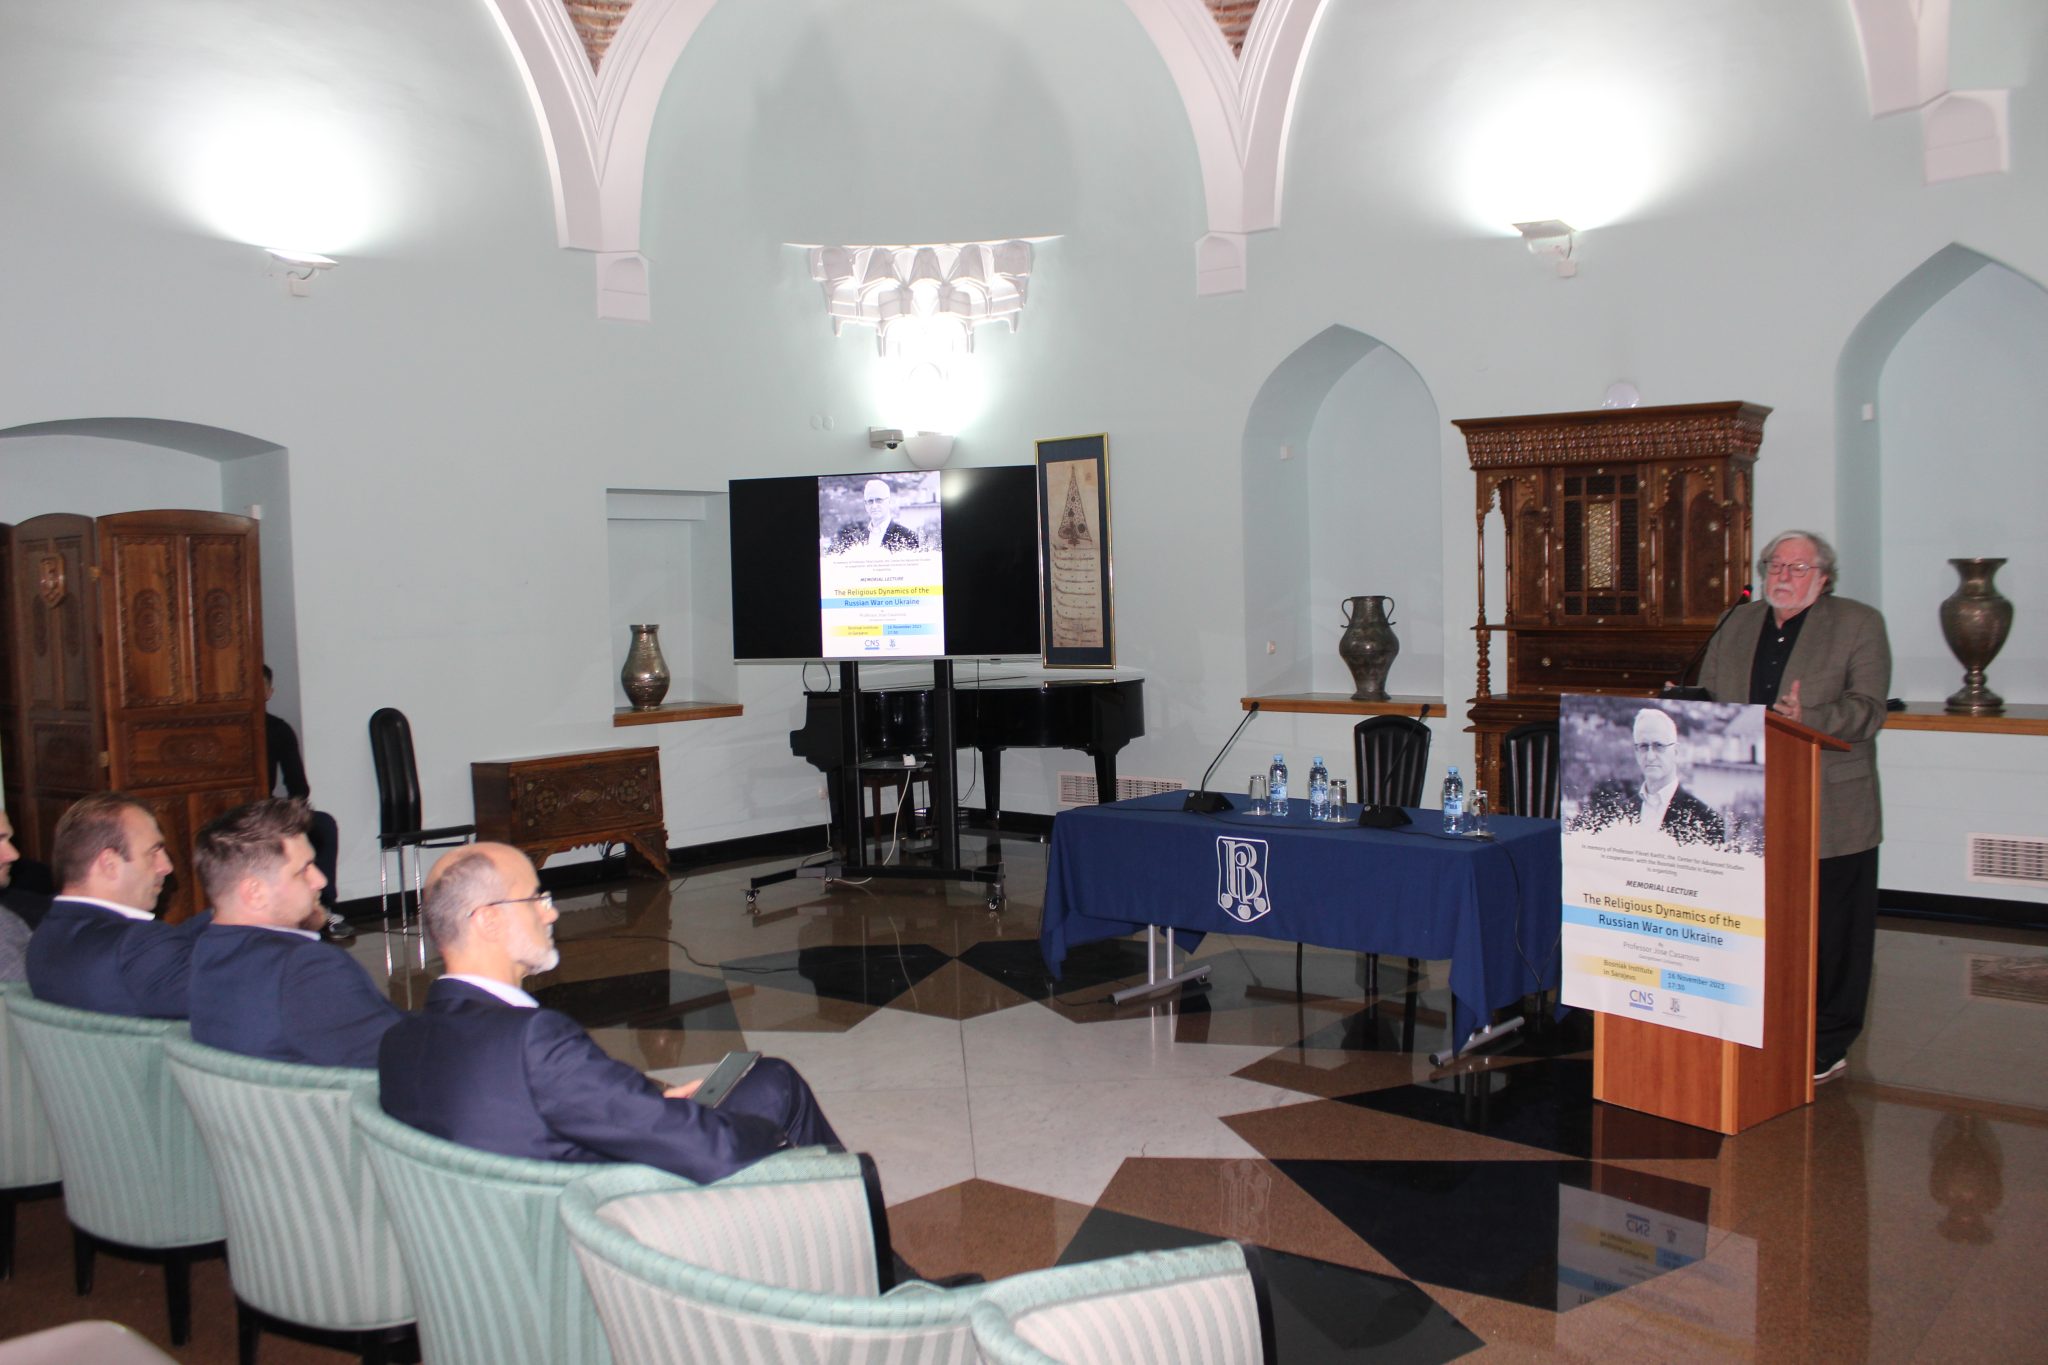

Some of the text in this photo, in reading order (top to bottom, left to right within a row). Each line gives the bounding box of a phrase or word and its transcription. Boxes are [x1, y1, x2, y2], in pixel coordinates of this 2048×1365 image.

[847, 588, 877, 597] Religious
[878, 588, 909, 597] Dynamics
[910, 586, 918, 594] of
[919, 586, 930, 594] the
[1626, 880, 1699, 898] MEMORIAL LECTURE
[1582, 893, 1741, 929] The Religious Dynamics of the
[1599, 914, 1724, 946] Russian War on Ukraine
[1623, 941, 1652, 953] Professor
[1668, 950, 1700, 962] Casanova
[1603, 959, 1627, 969] Bosniak
[1611, 970, 1637, 981] Sarajevo
[1677, 973, 1708, 986] November
[1629, 989, 1654, 1005] CNS
